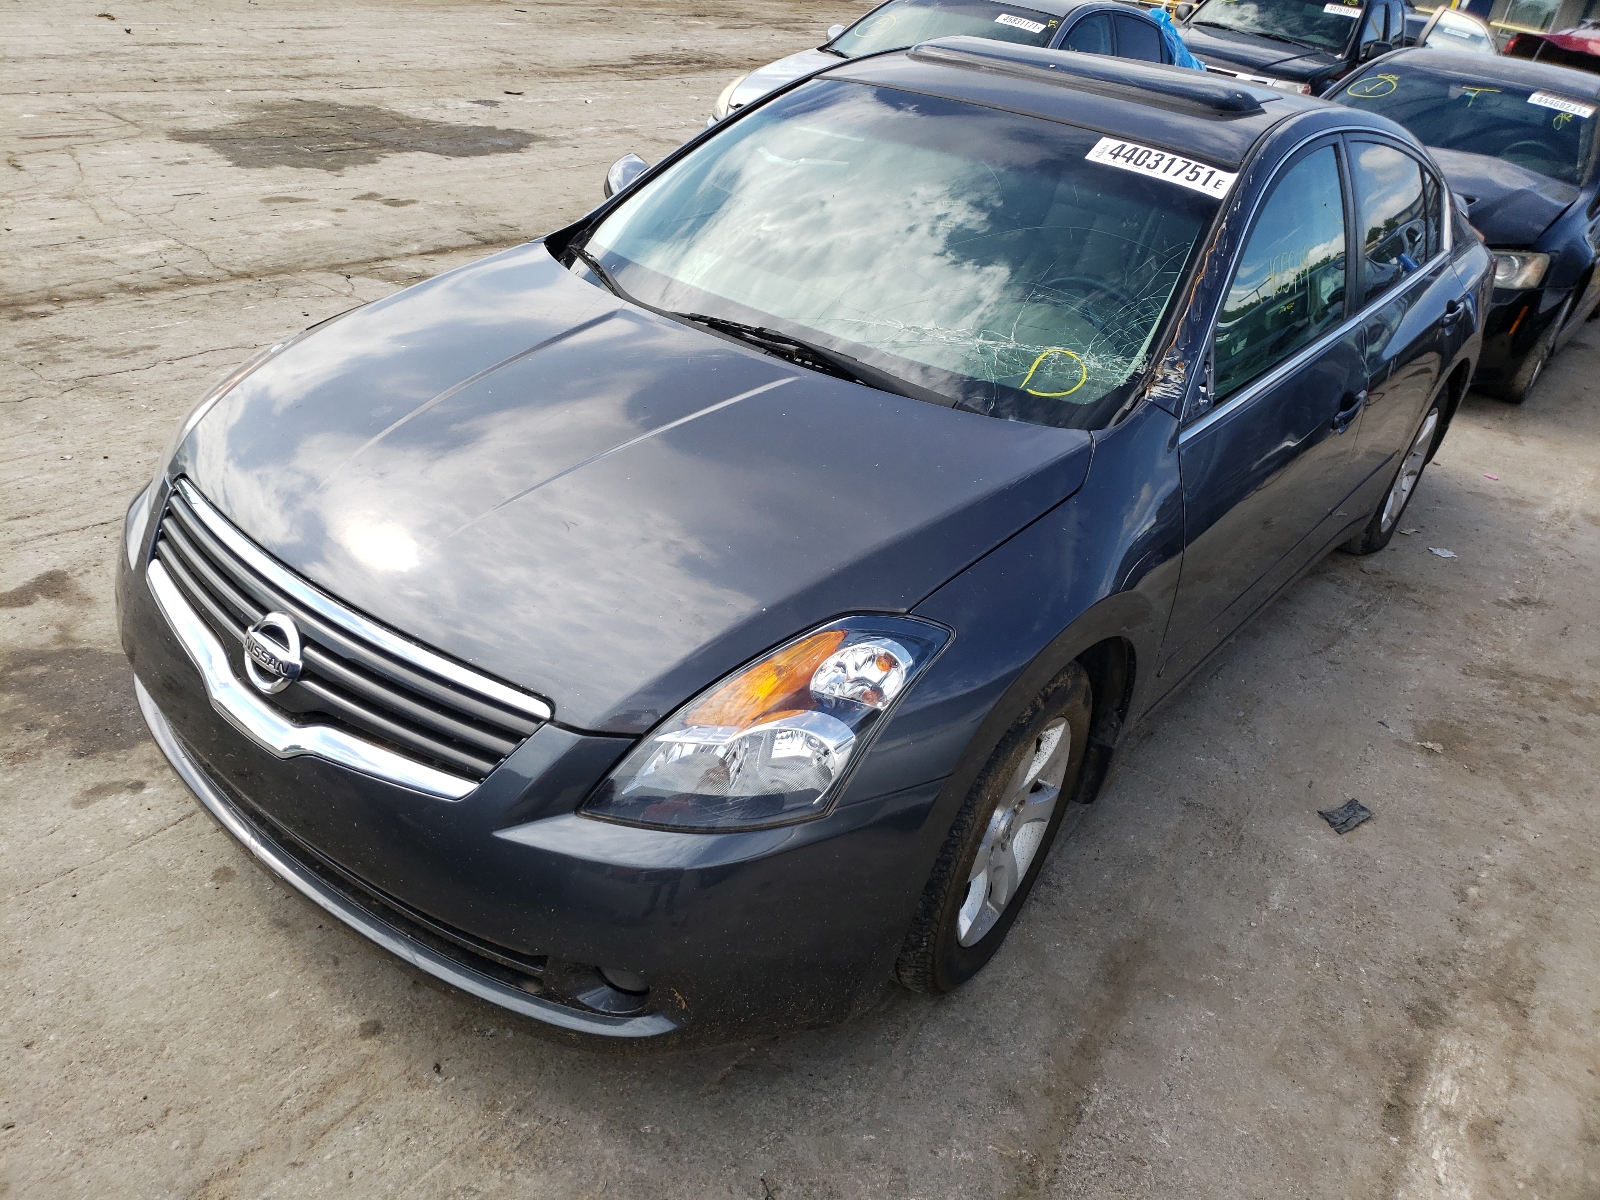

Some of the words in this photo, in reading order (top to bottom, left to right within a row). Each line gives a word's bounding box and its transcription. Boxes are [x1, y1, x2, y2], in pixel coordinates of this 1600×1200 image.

[1108, 143, 1216, 187] 44031751
[1213, 179, 1225, 190] E
[245, 636, 290, 676] NISSAN
